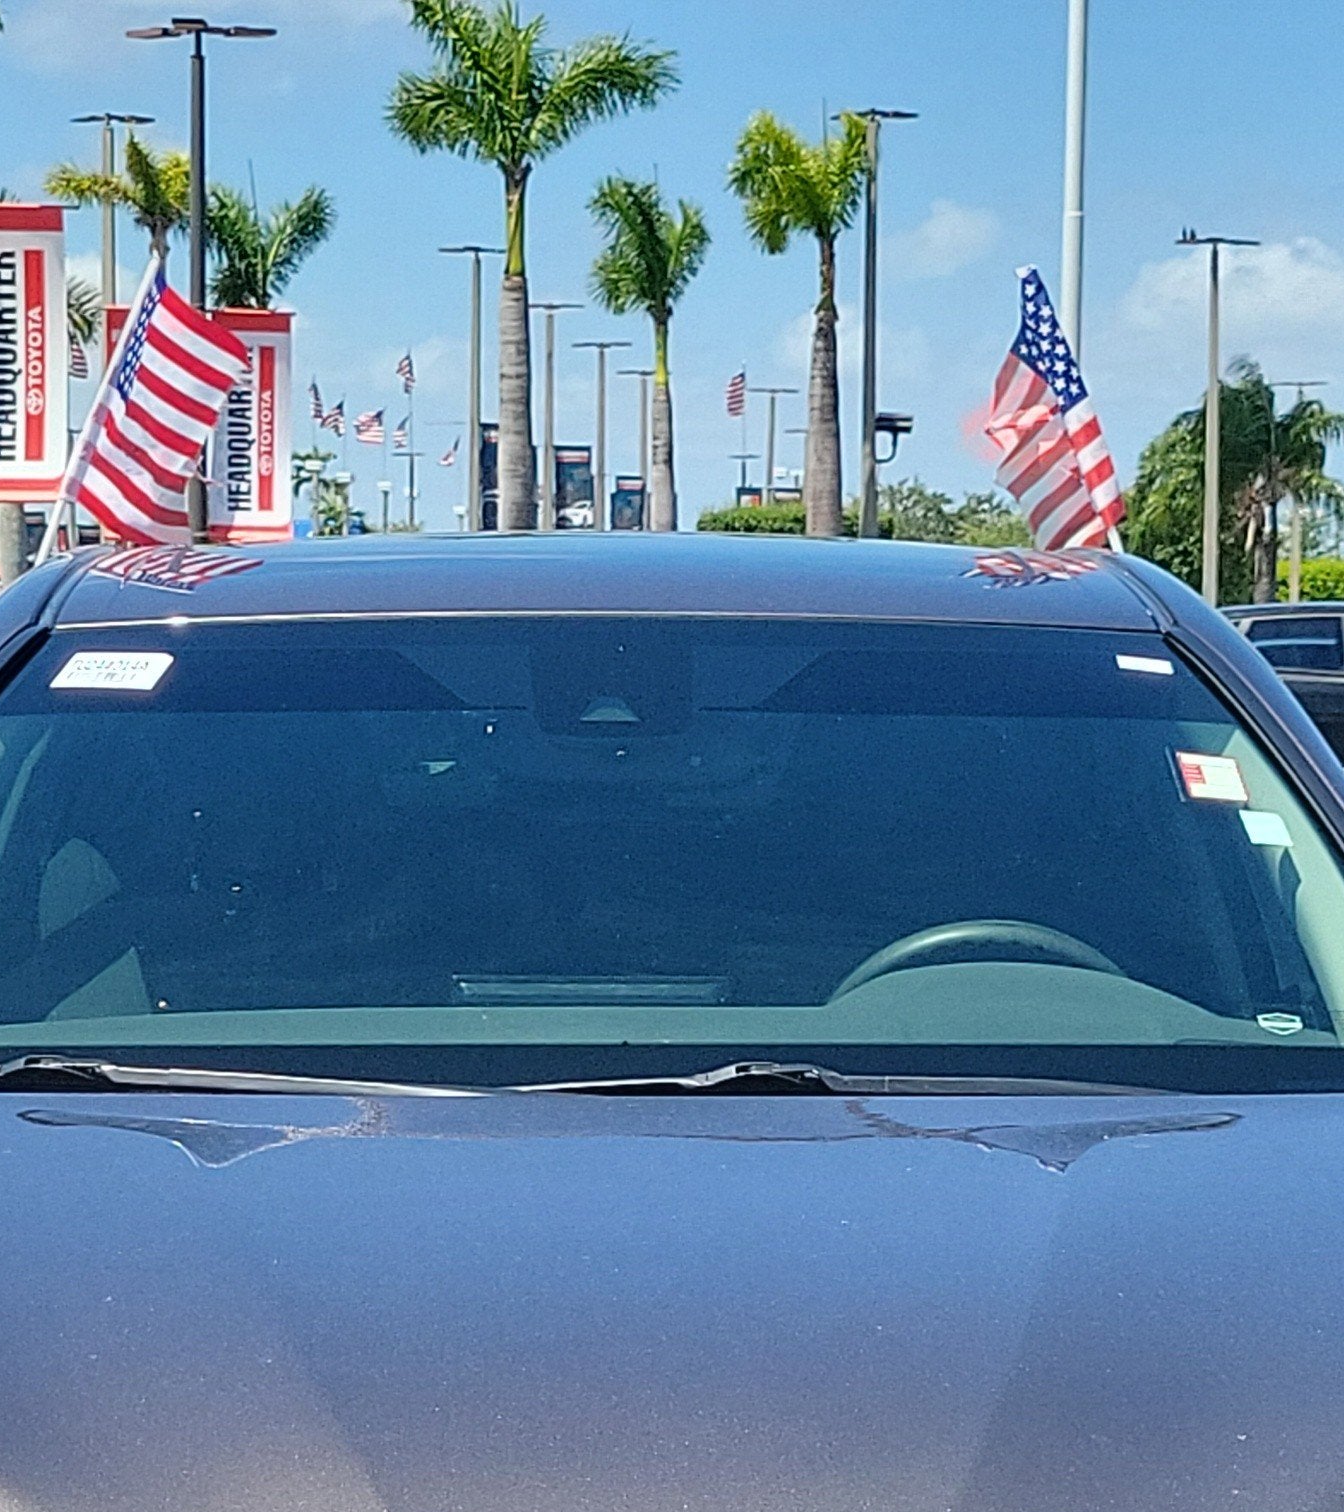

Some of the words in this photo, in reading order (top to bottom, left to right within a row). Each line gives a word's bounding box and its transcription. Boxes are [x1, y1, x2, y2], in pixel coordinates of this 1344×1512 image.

[27, 306, 43, 387] TOYOTA
[227, 347, 256, 512] HEADQUAR
[259, 391, 272, 453] TOYOTA
